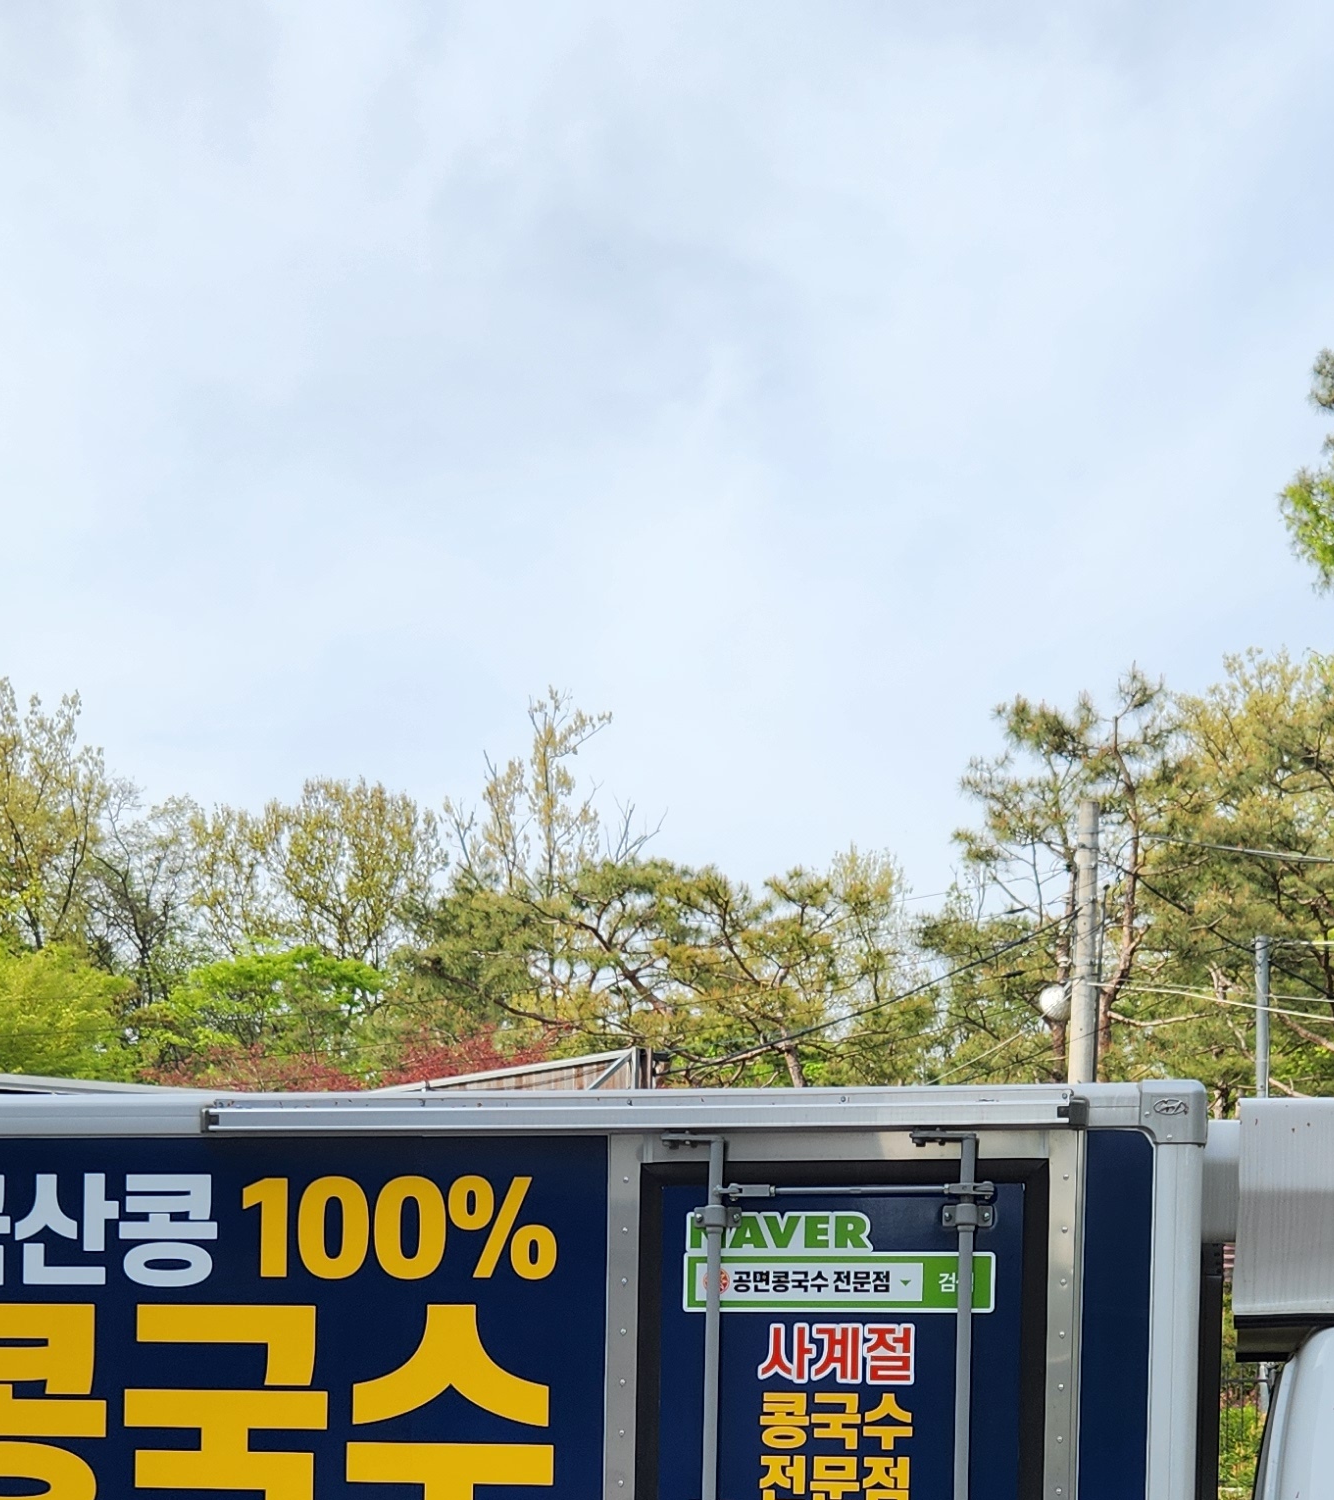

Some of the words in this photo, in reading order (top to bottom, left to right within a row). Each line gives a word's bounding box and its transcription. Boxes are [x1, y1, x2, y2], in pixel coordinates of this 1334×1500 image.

[242, 1175, 557, 1280] 100%
[733, 1270, 829, 1293] 공면콩국수
[833, 1270, 891, 1293] 전문점
[938, 1271, 975, 1294] 검
[758, 1323, 915, 1384] 사계절
[760, 1392, 913, 1450] 콩국수
